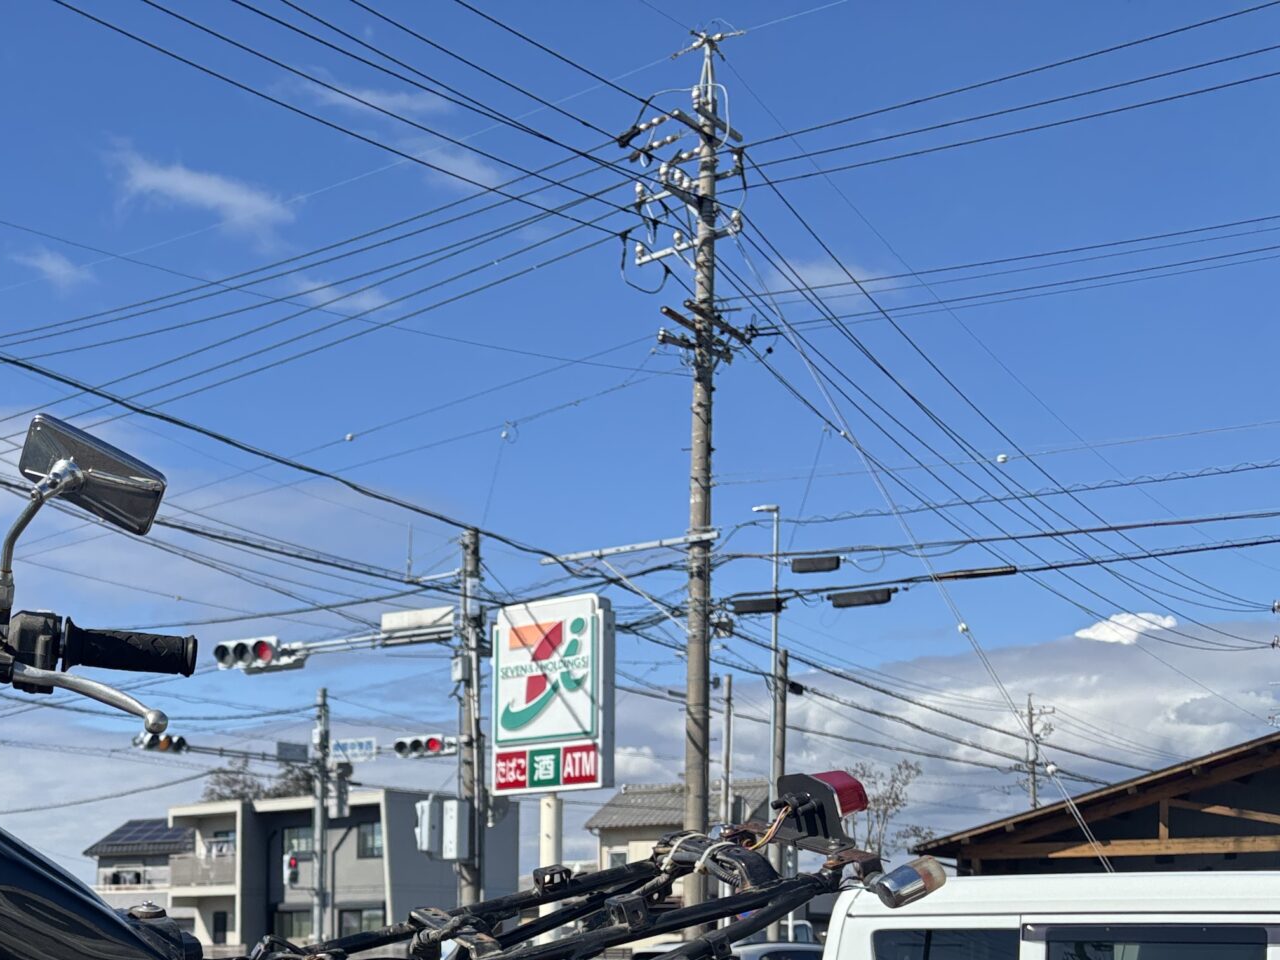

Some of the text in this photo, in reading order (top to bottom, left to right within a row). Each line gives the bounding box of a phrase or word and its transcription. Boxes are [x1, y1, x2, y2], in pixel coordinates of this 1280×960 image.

[496, 750, 596, 784] たばこ 酒 ATM
